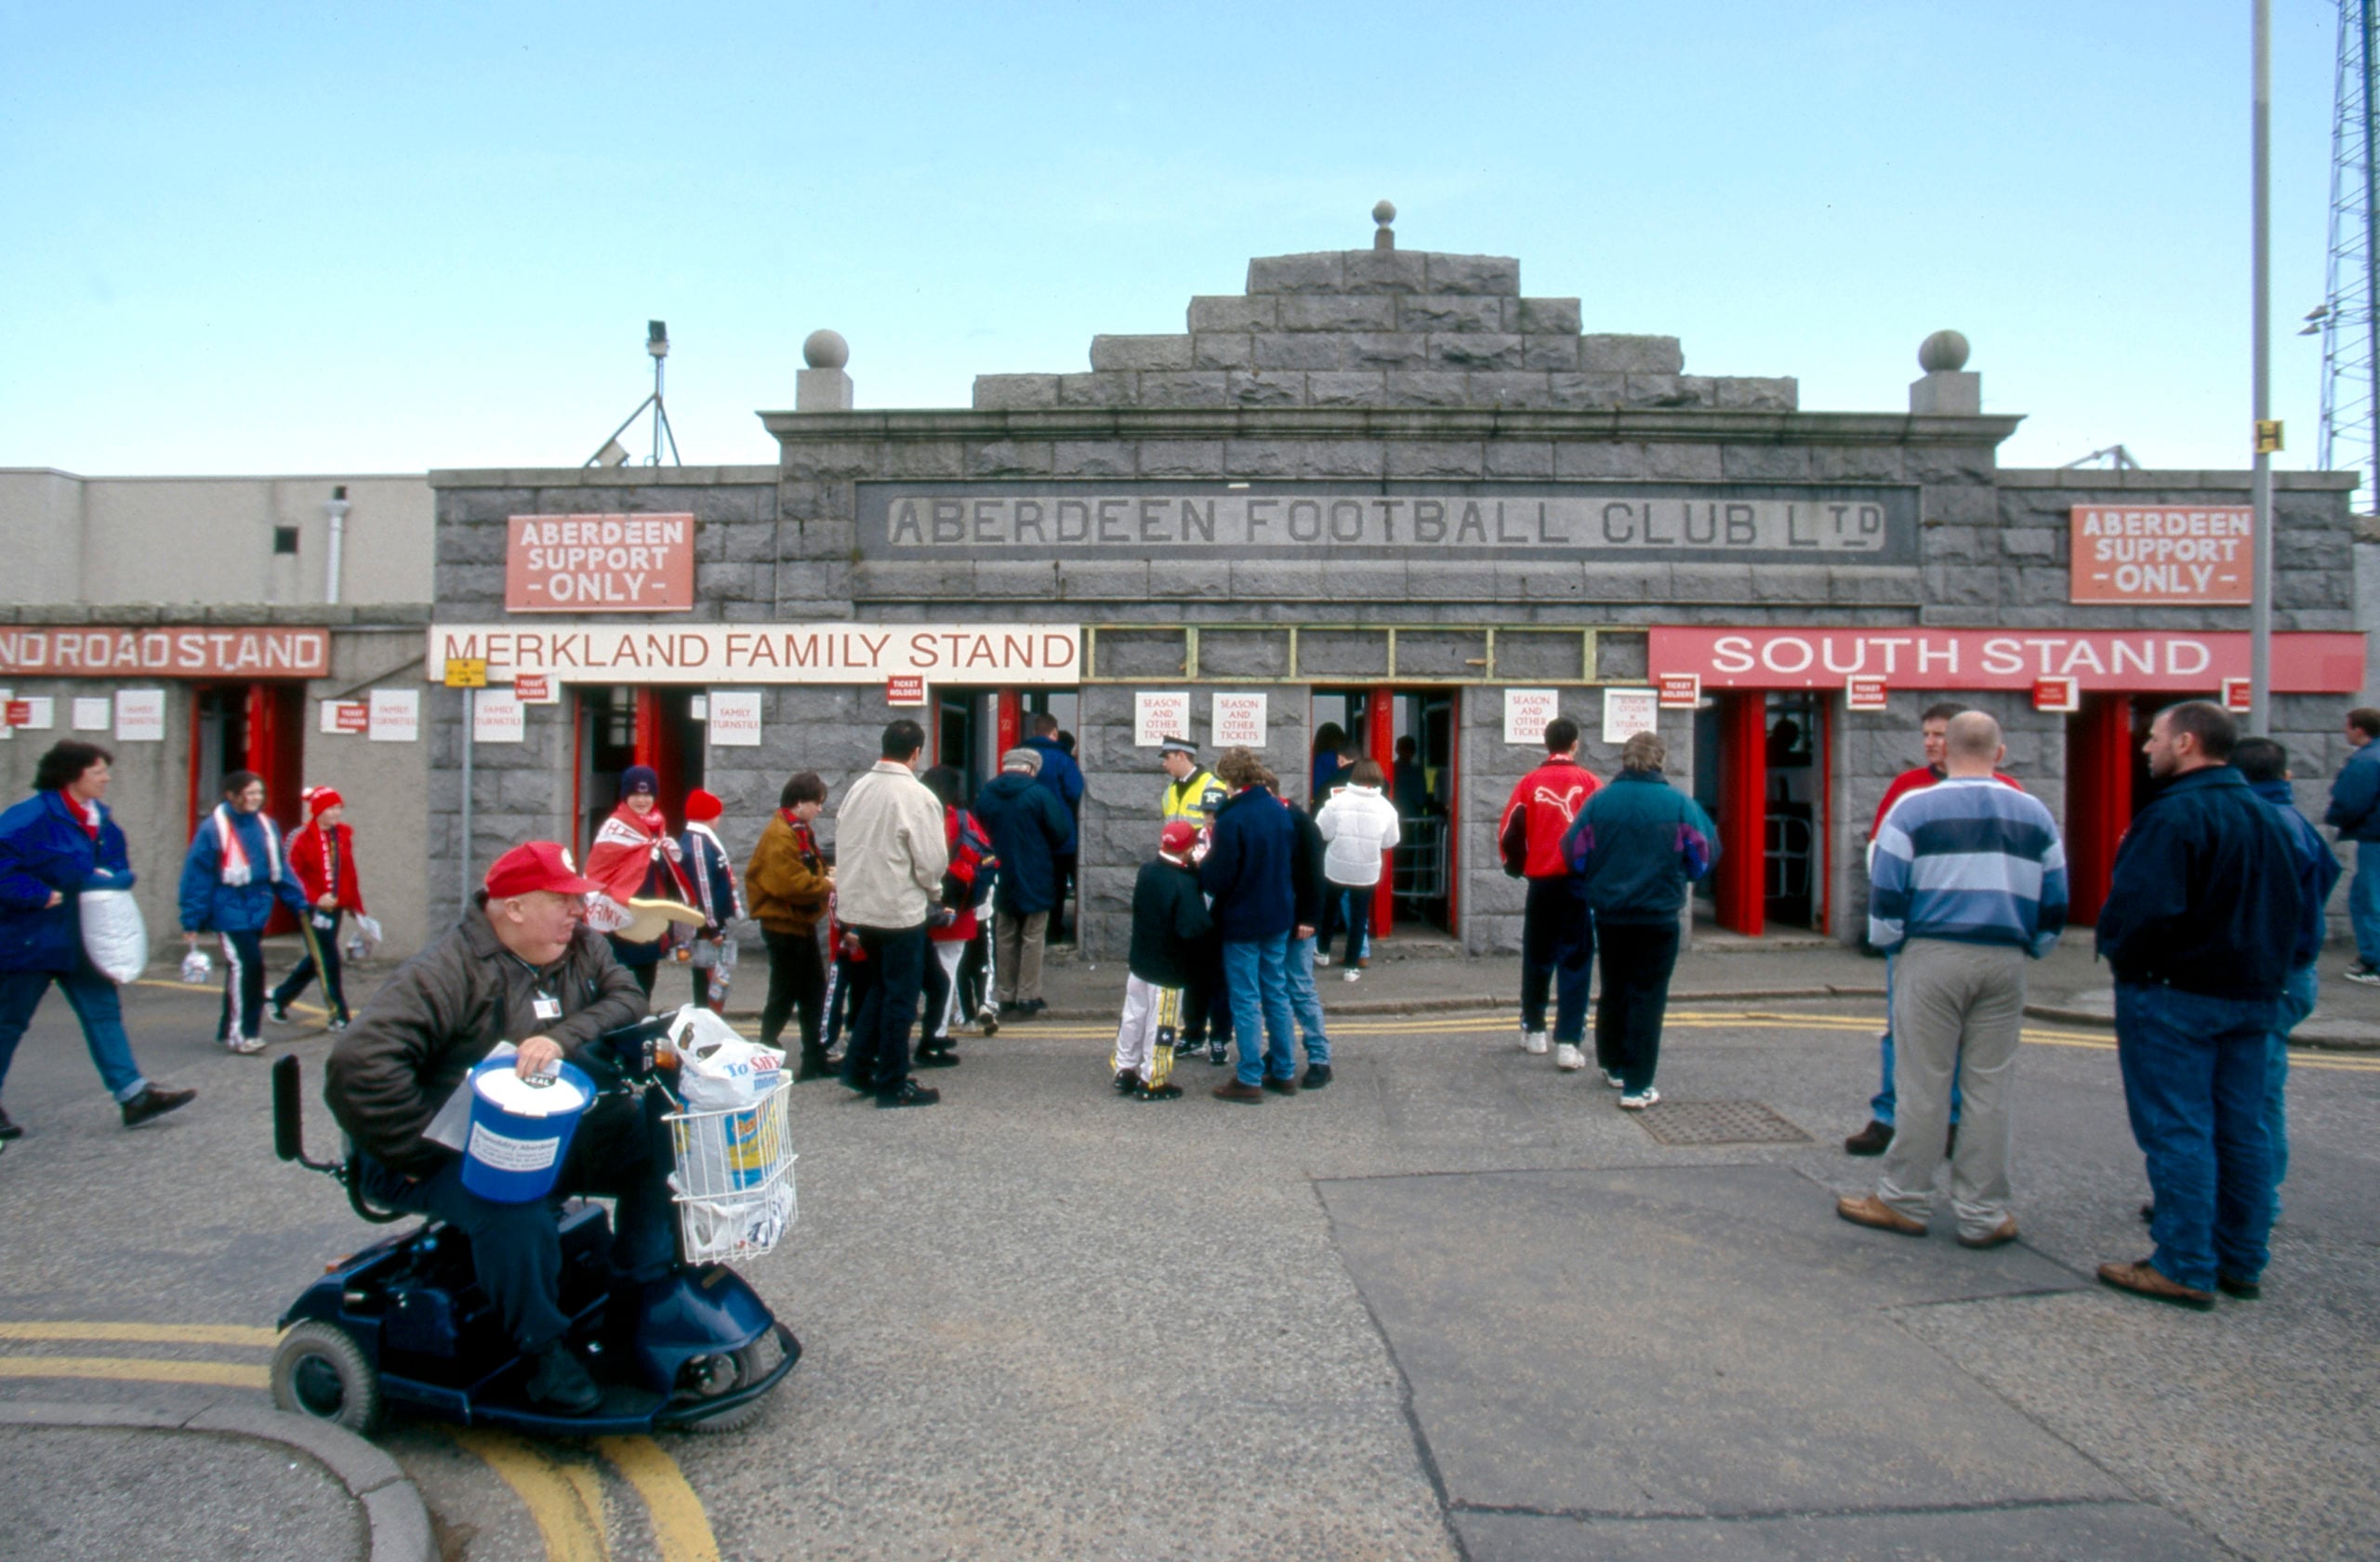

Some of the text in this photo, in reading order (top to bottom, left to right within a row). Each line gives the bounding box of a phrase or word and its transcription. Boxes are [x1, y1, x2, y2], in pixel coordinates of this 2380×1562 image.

[892, 499, 1880, 547] ABERDEEN FOOTBALL CLUB LTD
[2082, 511, 2251, 536] ABERDEEN
[520, 521, 683, 546] ABERDEEN
[2095, 537, 2240, 562] SUPPORT
[528, 547, 668, 571] SUPPORT
[178, 633, 322, 668] STAND
[445, 633, 1076, 668] MERKLAND FAMILY STAND
[1712, 636, 2210, 675] SOUTH STAND
[892, 680, 919, 688] TICKET
[889, 689, 921, 697] HOLDERS
[1661, 690, 1695, 698] HOLDERS
[1144, 698, 1182, 708] SEASON
[1221, 699, 1259, 708] SEASON
[1513, 696, 1550, 705] SEASON
[483, 705, 514, 714] FAMILY
[720, 708, 751, 717] FAMILY
[1152, 709, 1173, 718] AND
[1521, 707, 1542, 715] AND
[1229, 710, 1250, 719] AND
[712, 720, 759, 729] TURNSTILE
[1145, 720, 1178, 729] OTHER
[1223, 721, 1255, 730] OTHER
[1515, 717, 1547, 726] OTHER
[1221, 731, 1258, 740] TICKETS
[723, 1063, 748, 1078] To
[523, 1076, 550, 1087] SEAL
